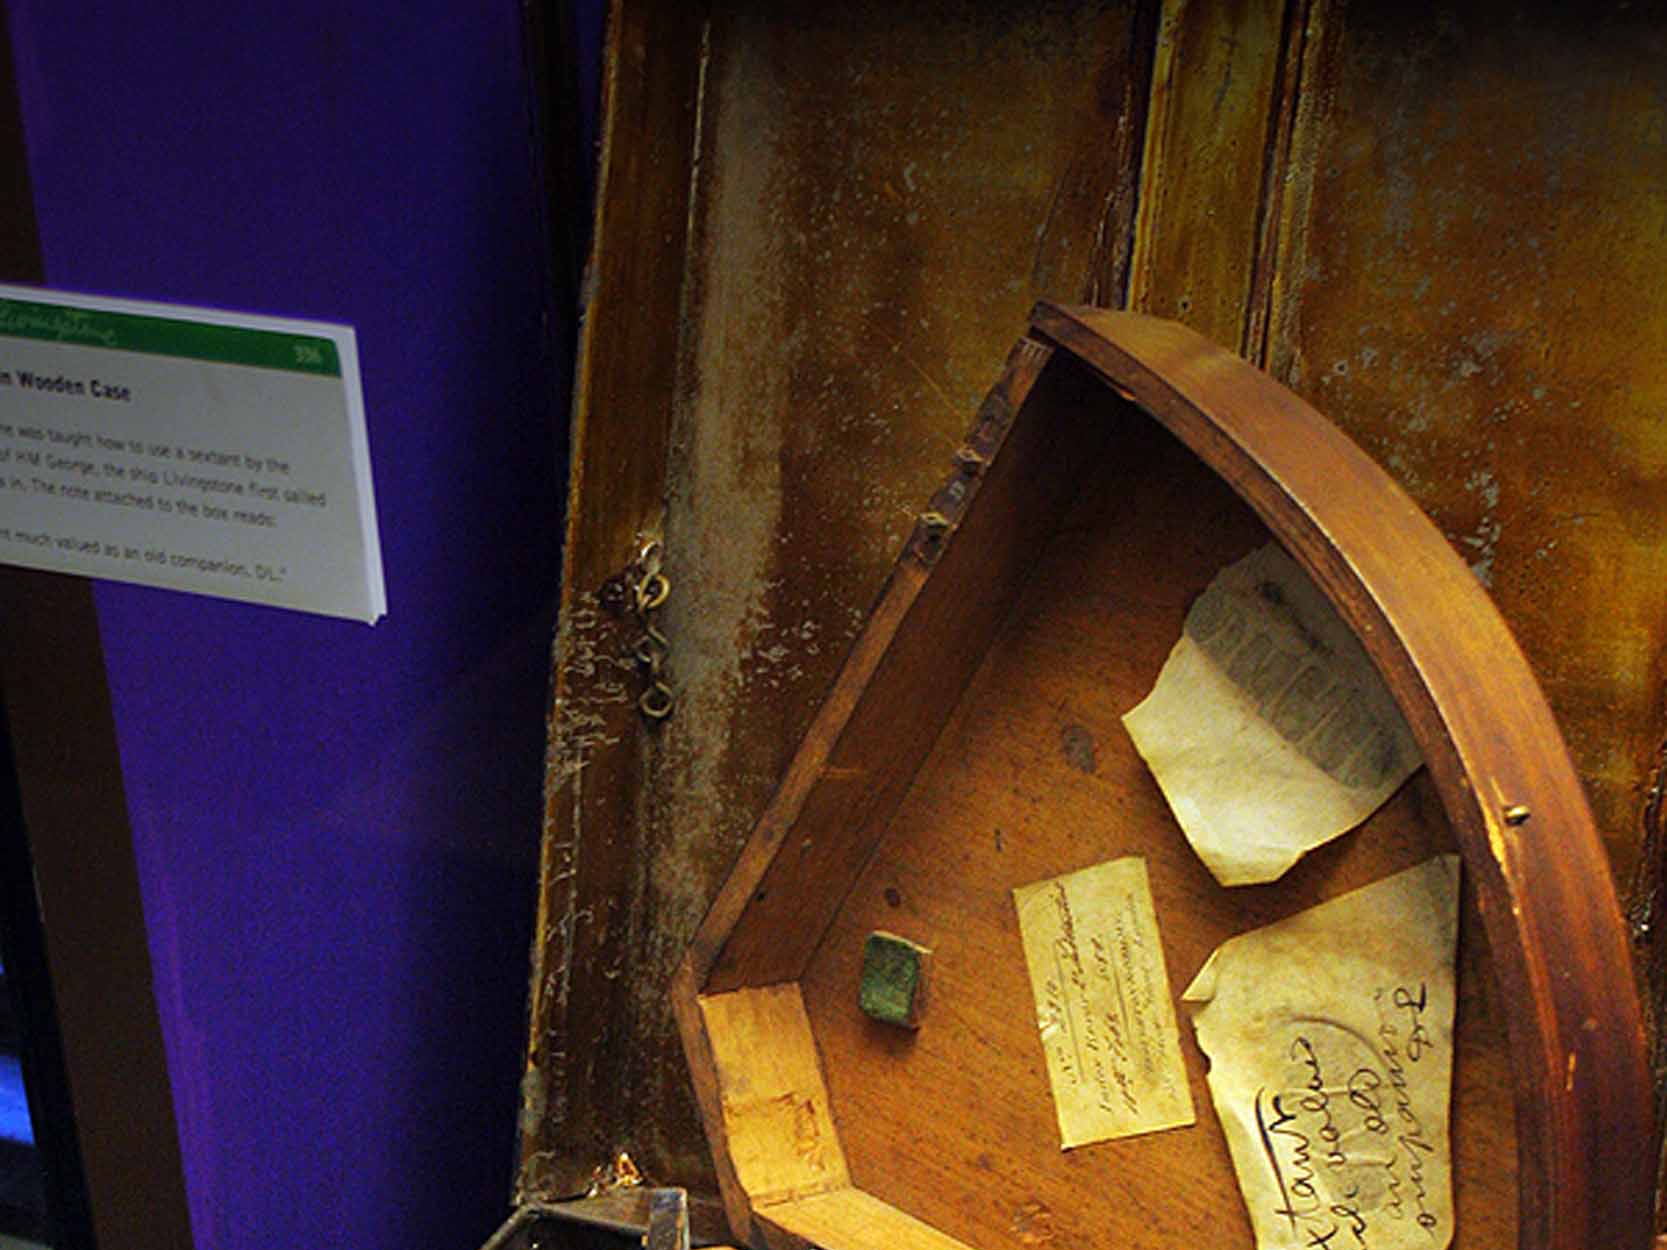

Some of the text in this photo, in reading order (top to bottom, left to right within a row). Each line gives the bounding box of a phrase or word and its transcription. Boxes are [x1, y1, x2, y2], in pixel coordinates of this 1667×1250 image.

[16, 369, 85, 395] Wooden
[90, 379, 131, 402] Case
[18, 427, 43, 440] was
[47, 428, 92, 447] taught
[96, 432, 125, 450] how
[128, 440, 144, 454] to
[150, 445, 171, 459] use
[188, 448, 241, 467] sextant
[244, 455, 262, 472] by
[266, 457, 290, 475] the
[32, 477, 55, 494] The
[60, 484, 90, 500] note
[94, 490, 154, 510] attached
[157, 497, 173, 513] to
[176, 498, 199, 518] the
[202, 504, 228, 521] box
[103, 463, 125, 477] the
[129, 467, 158, 485] ship
[164, 469, 244, 495] Livingstone
[248, 479, 279, 500] first
[15, 530, 51, 547] much
[55, 537, 100, 555] valued
[104, 544, 120, 558] as
[124, 547, 140, 560] an
[144, 549, 166, 566] old
